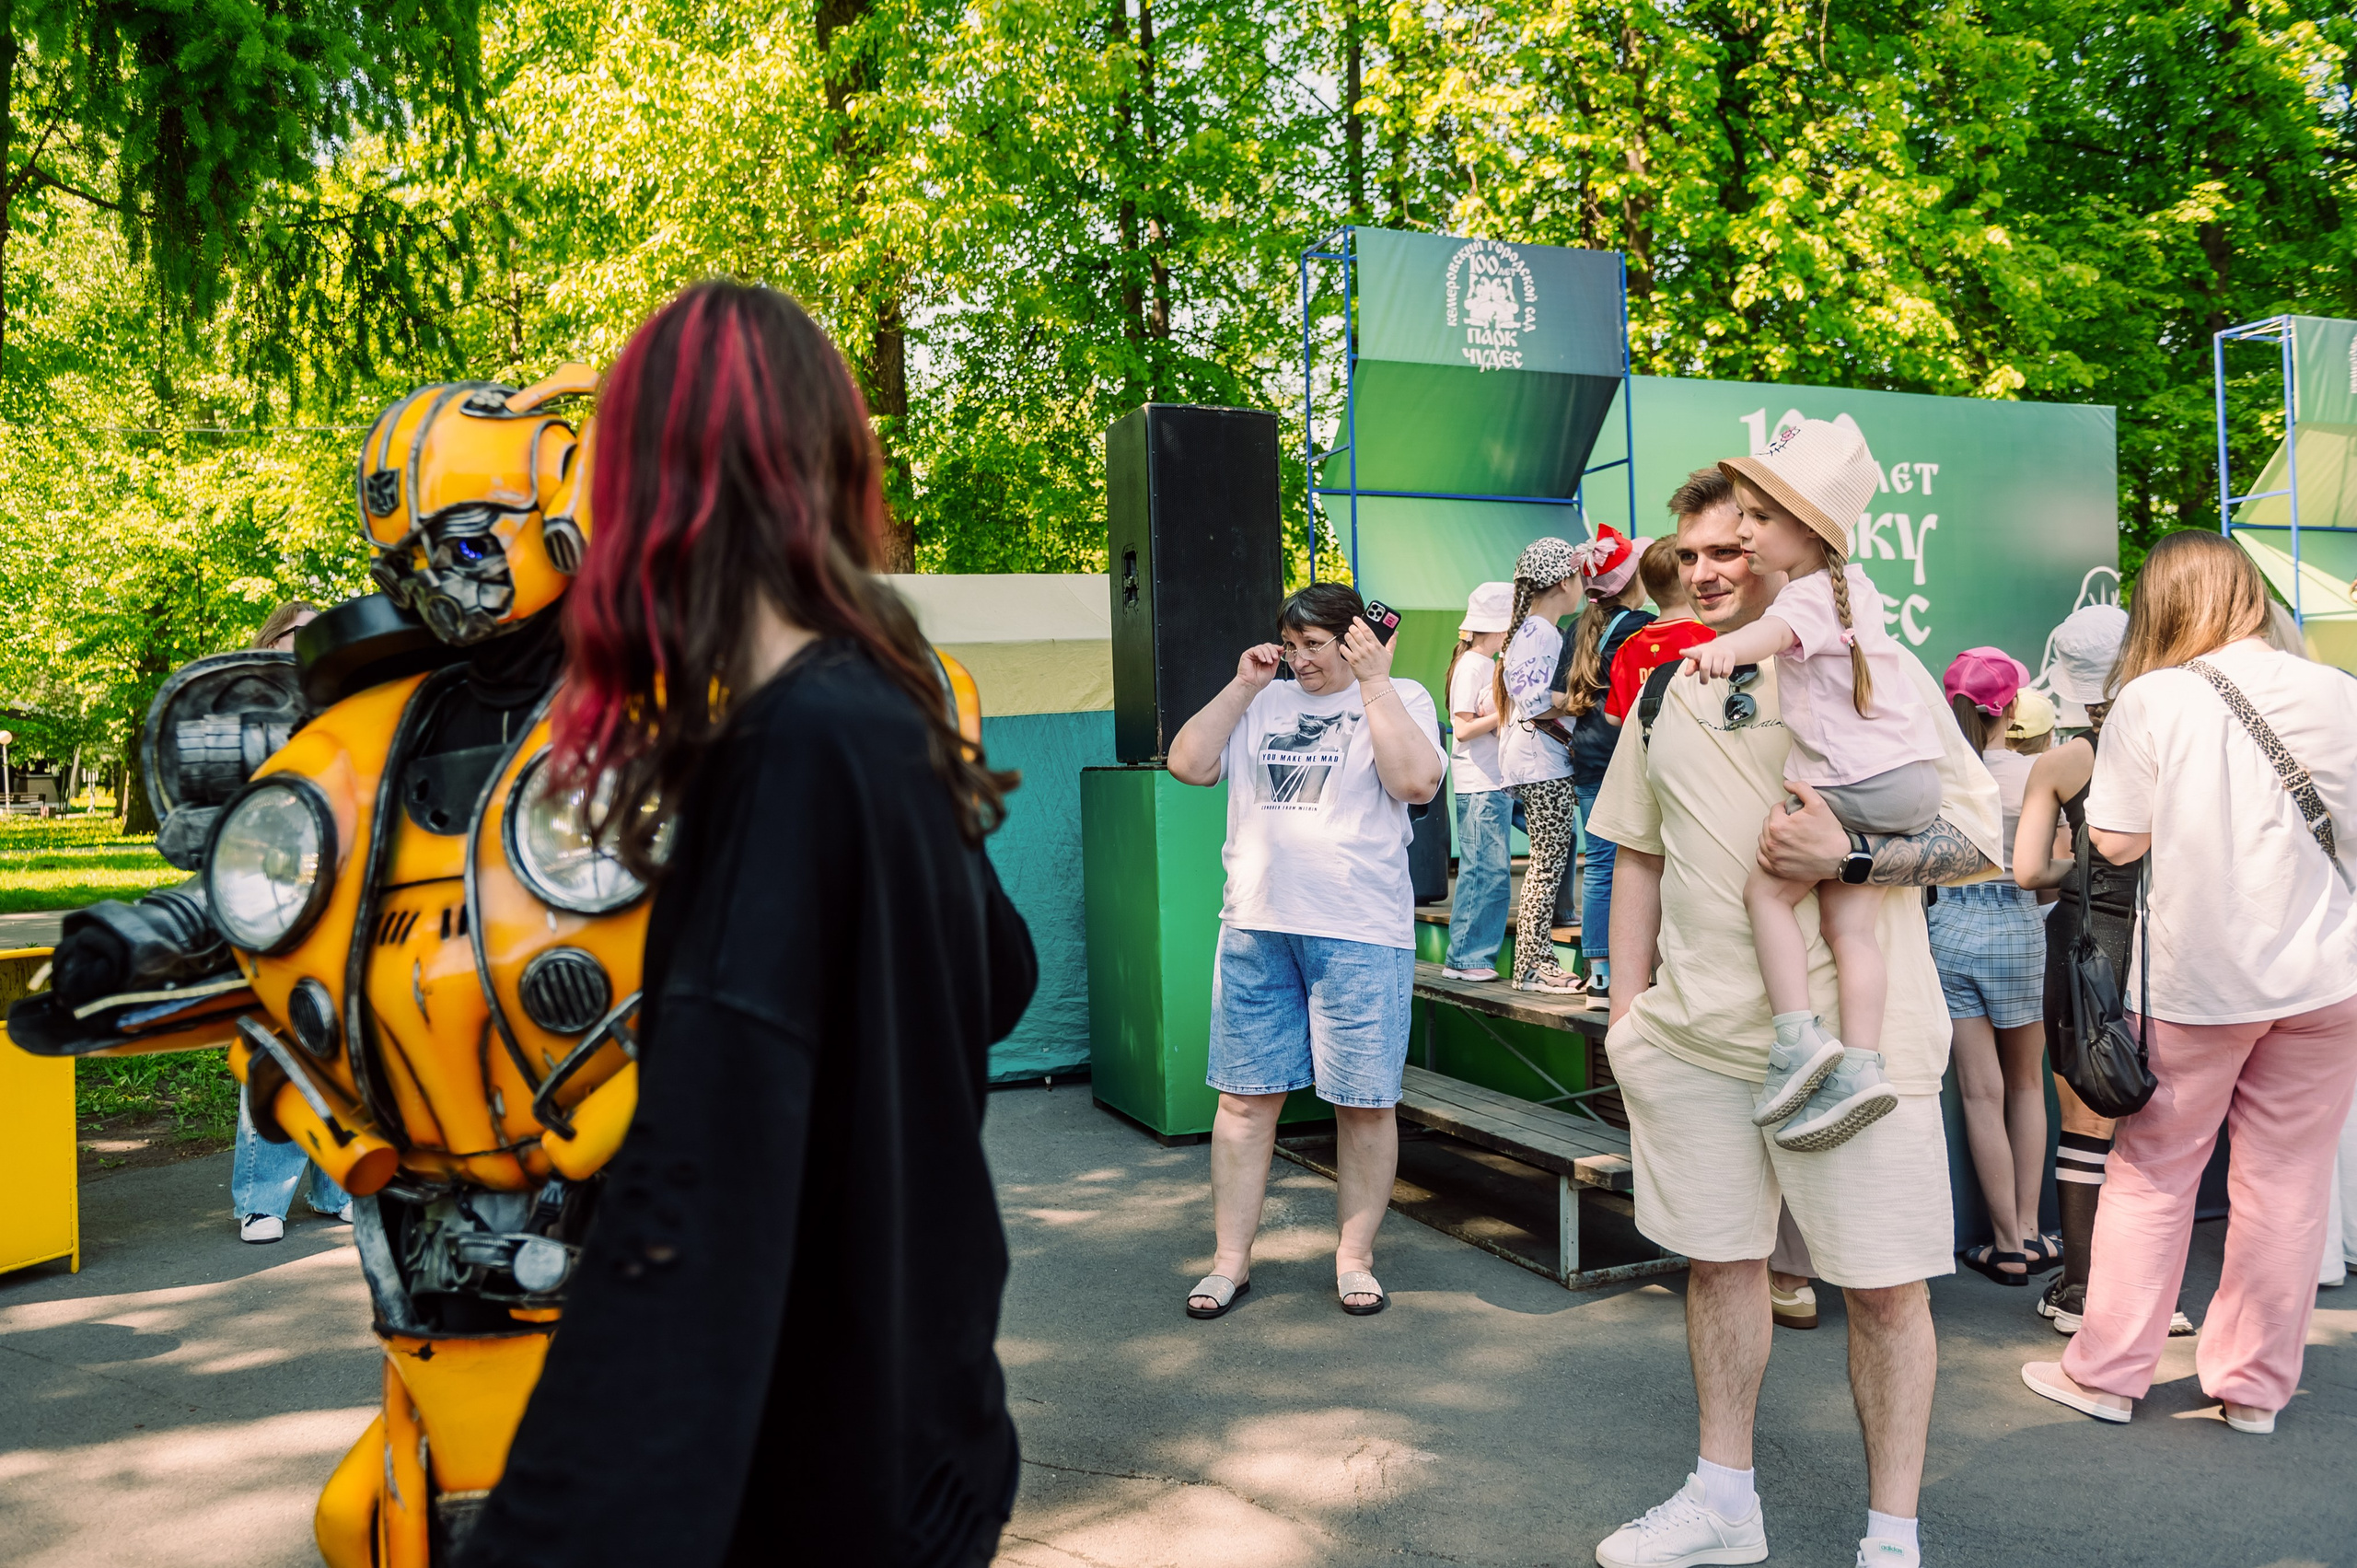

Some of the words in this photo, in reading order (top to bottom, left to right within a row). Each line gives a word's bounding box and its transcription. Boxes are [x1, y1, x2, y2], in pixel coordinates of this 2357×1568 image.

[1469, 253, 1499, 275] 100
[1512, 666, 1550, 695] SKY
[1262, 753, 1276, 761] YOU
[1280, 754, 1301, 762] MAKE
[1320, 755, 1339, 763] MAD
[1880, 1545, 1903, 1554] adidas
